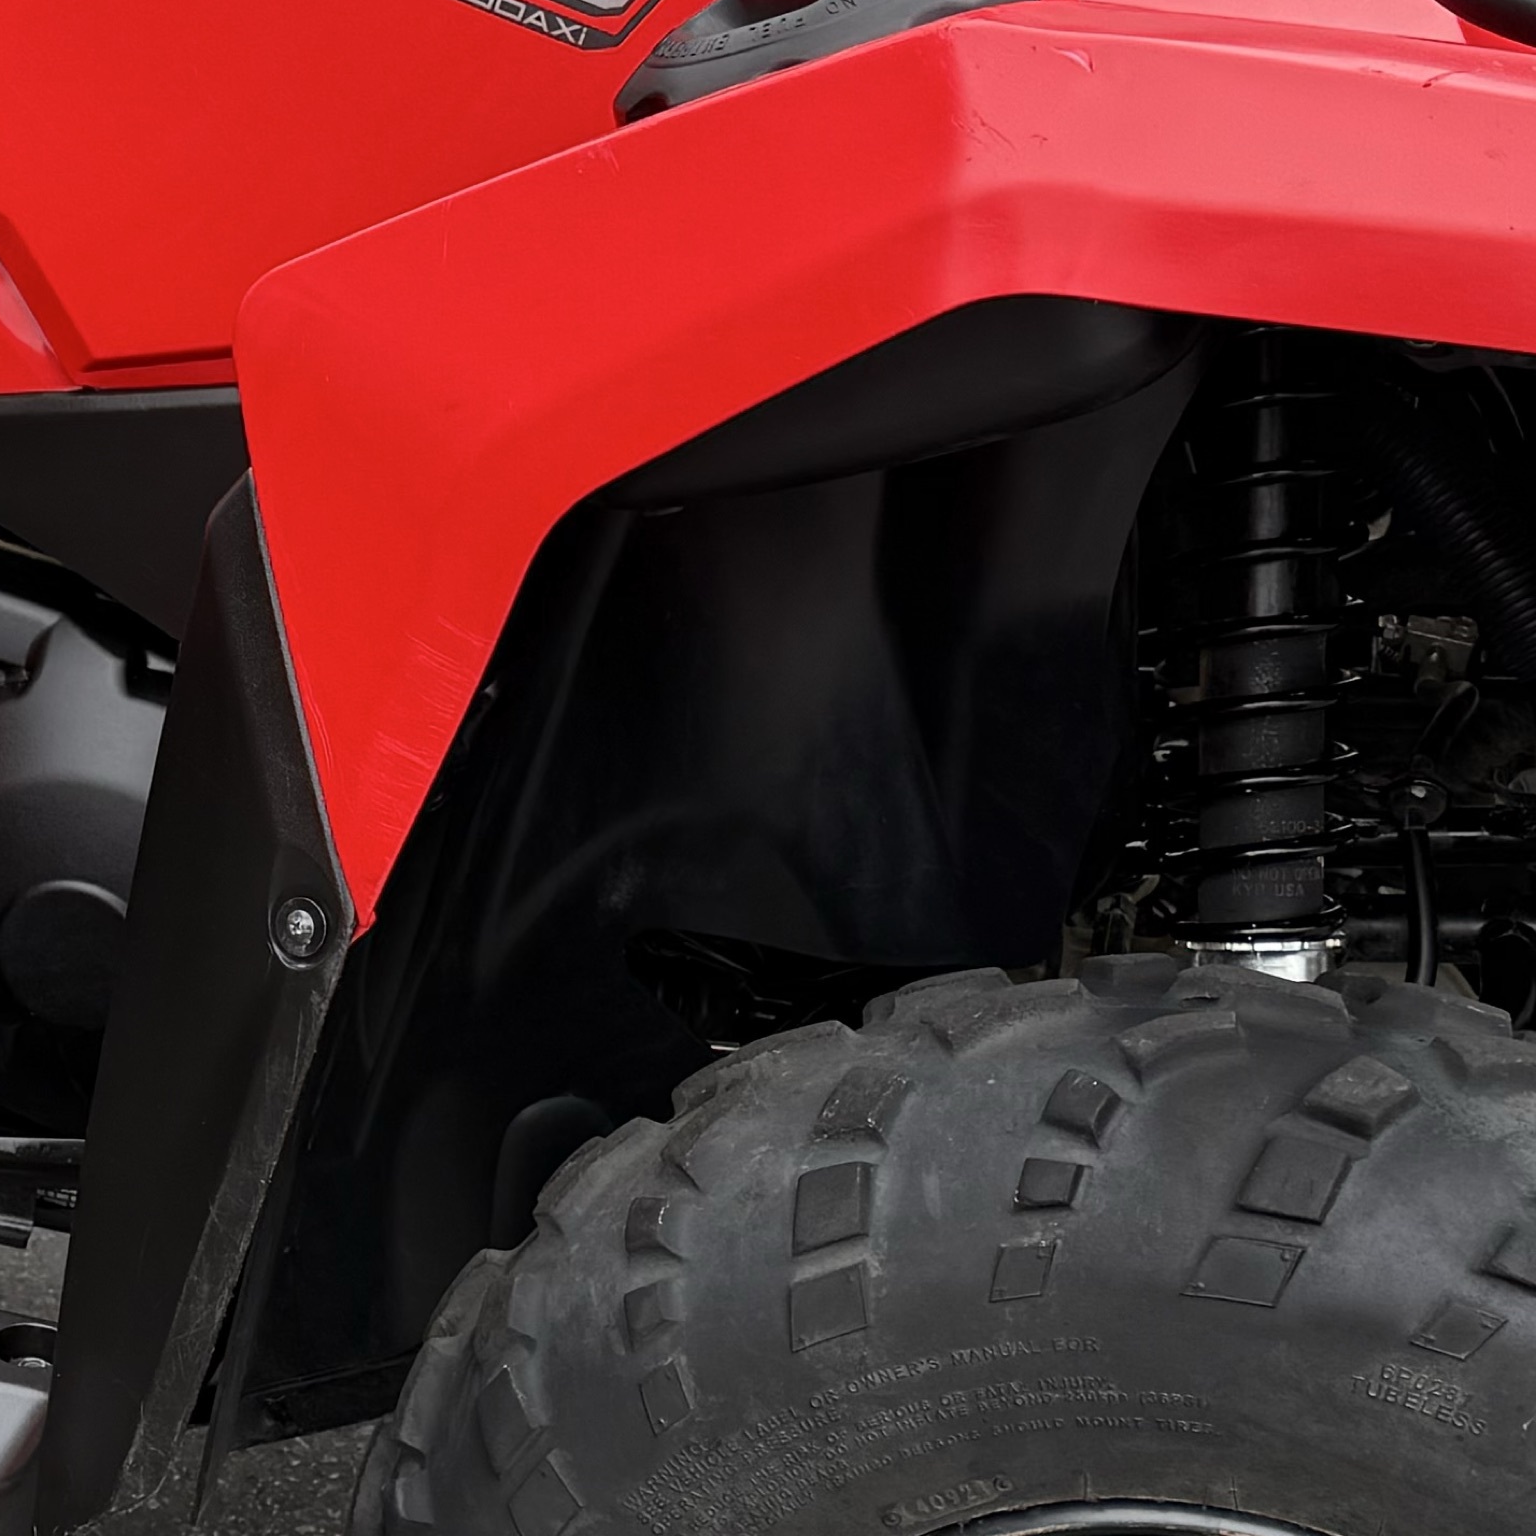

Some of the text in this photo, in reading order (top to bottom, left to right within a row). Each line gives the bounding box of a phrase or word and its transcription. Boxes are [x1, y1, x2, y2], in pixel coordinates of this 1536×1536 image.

[1274, 882, 1305, 897] USA
[743, 1405, 799, 1441] LABEL
[809, 1389, 840, 1409] OR
[846, 1356, 942, 1394] OWNER'S
[949, 1339, 1042, 1366] MANUAL
[1351, 1374, 1488, 1437] TUBELESS
